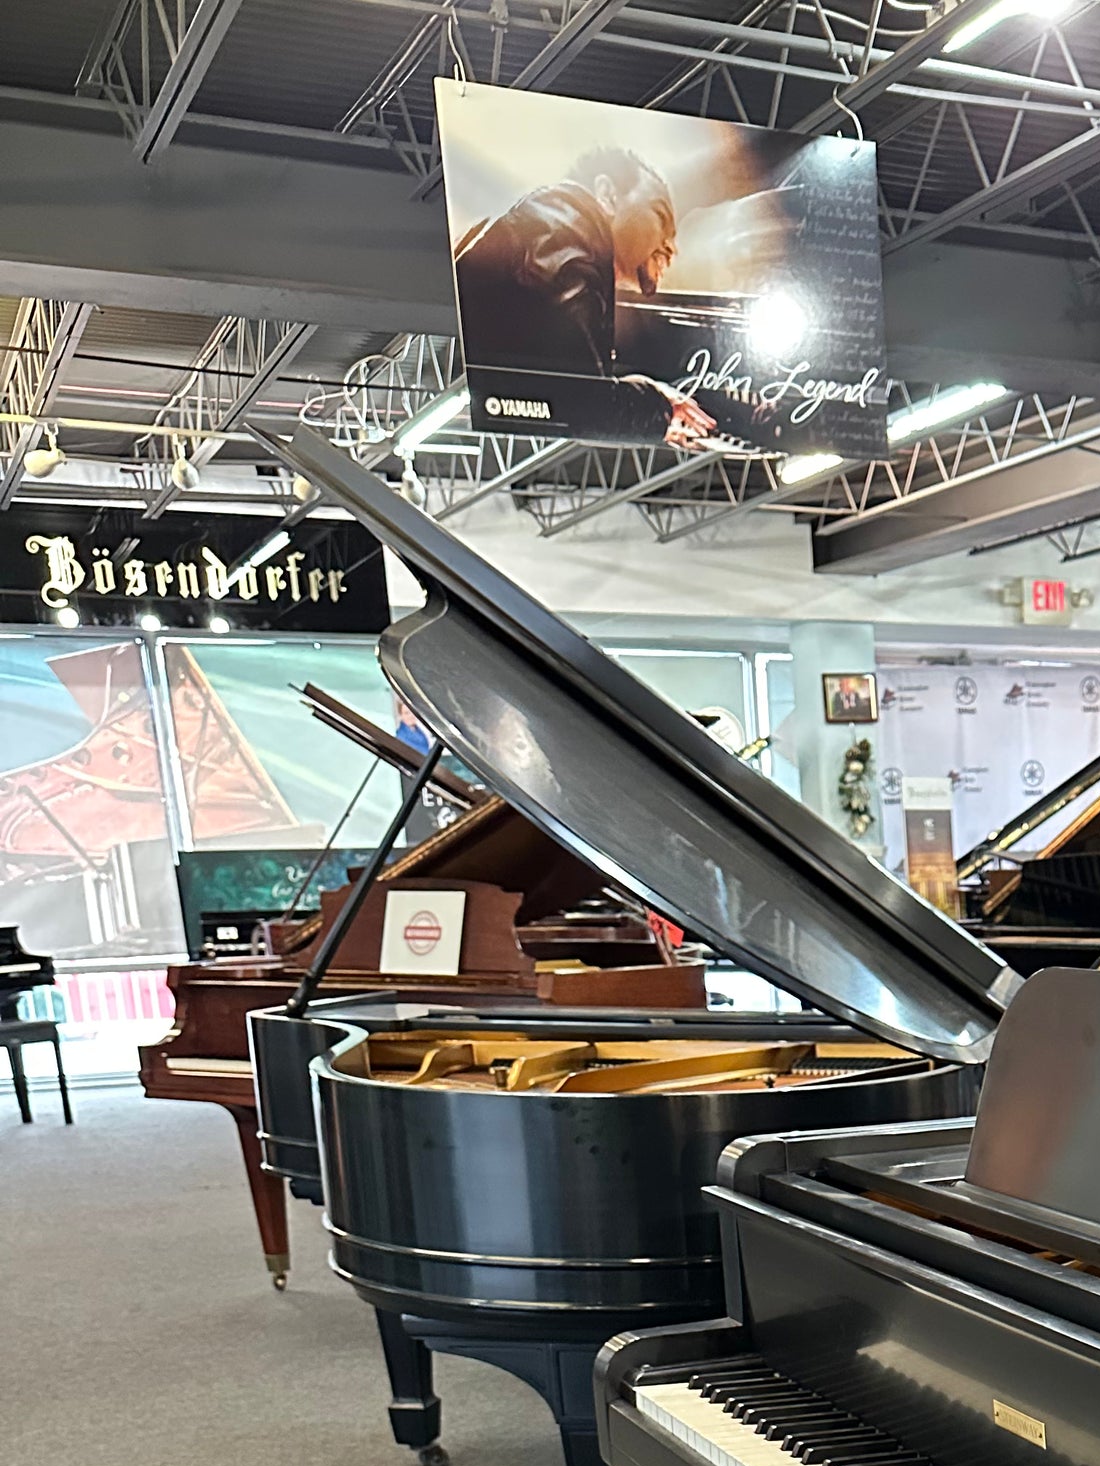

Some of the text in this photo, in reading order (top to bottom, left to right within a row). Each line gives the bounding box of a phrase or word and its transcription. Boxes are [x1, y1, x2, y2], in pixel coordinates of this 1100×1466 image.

[500, 398, 551, 419] YAMAHA
[676, 349, 880, 424] John Legend
[24, 535, 348, 608] Bösendorfer
[1032, 580, 1066, 612] EXIT
